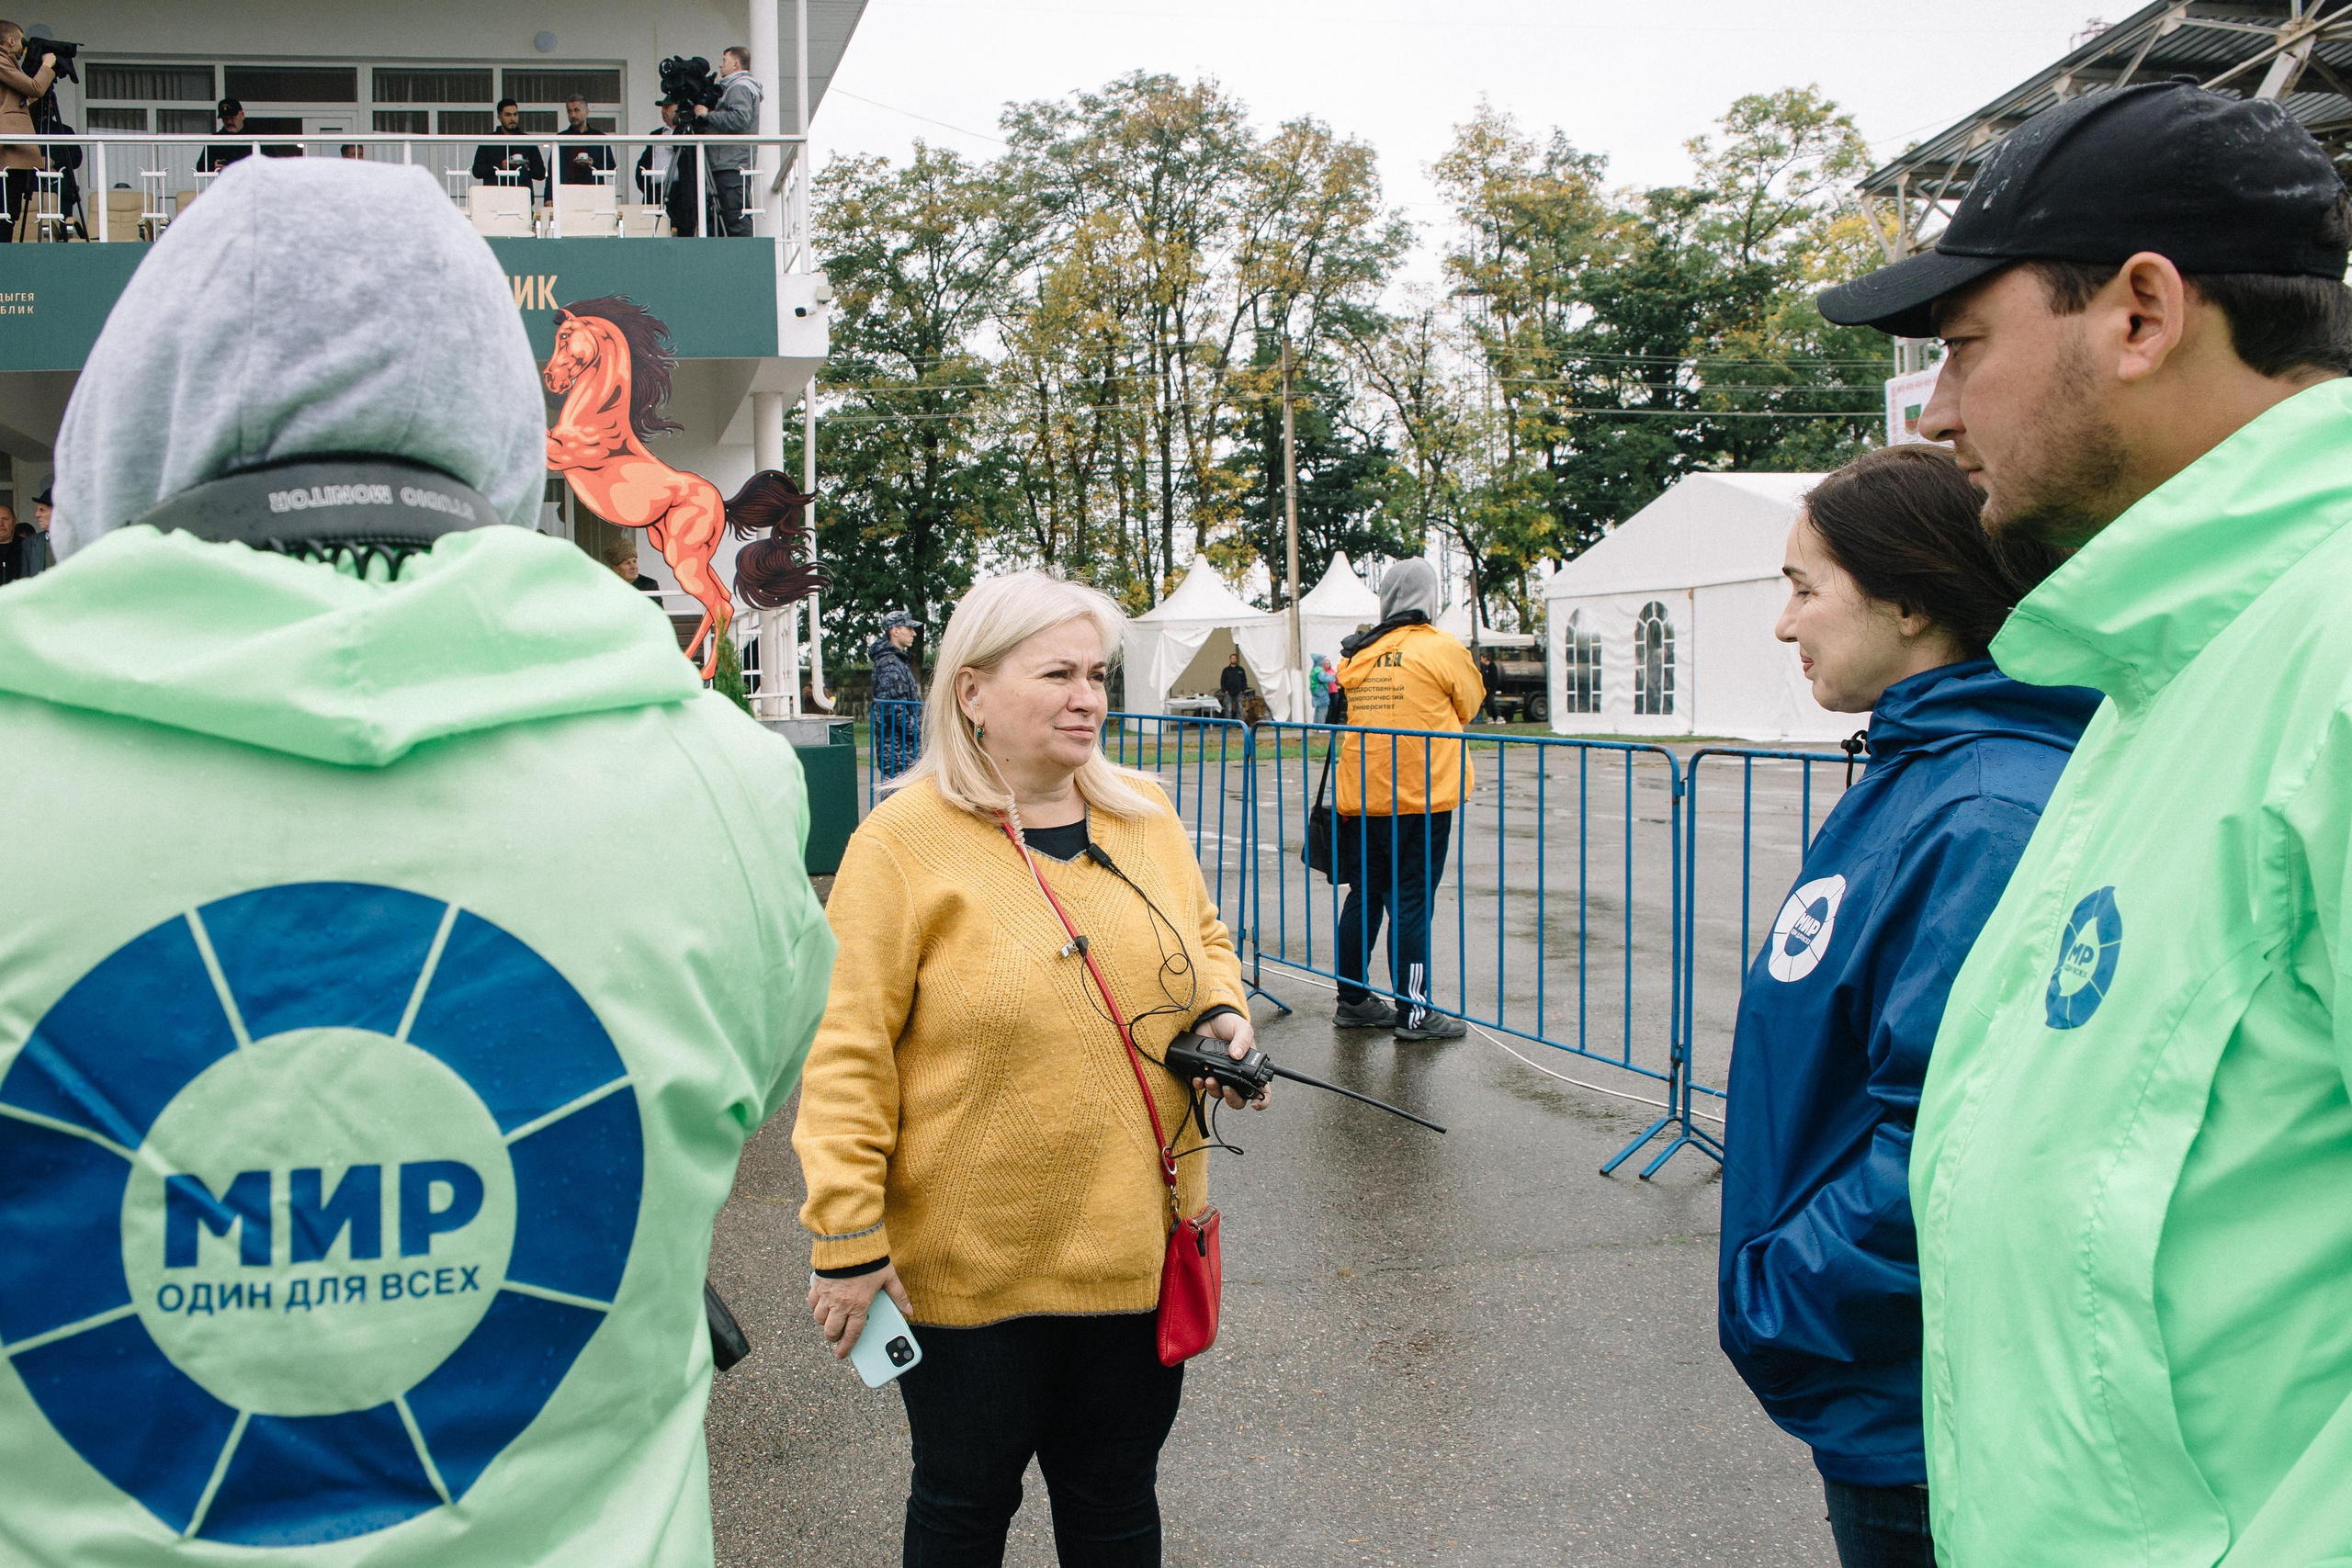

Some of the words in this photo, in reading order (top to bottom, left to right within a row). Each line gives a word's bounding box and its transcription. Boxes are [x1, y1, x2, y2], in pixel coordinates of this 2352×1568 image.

[506, 275, 560, 310] ИК
[268, 484, 394, 513] MONITOR
[400, 486, 476, 521] STUDIO
[164, 1160, 484, 1269] МИР
[157, 1282, 272, 1316] ОДИН
[285, 1275, 368, 1314] ДЛЯ
[380, 1265, 481, 1302] ВСЕХ
